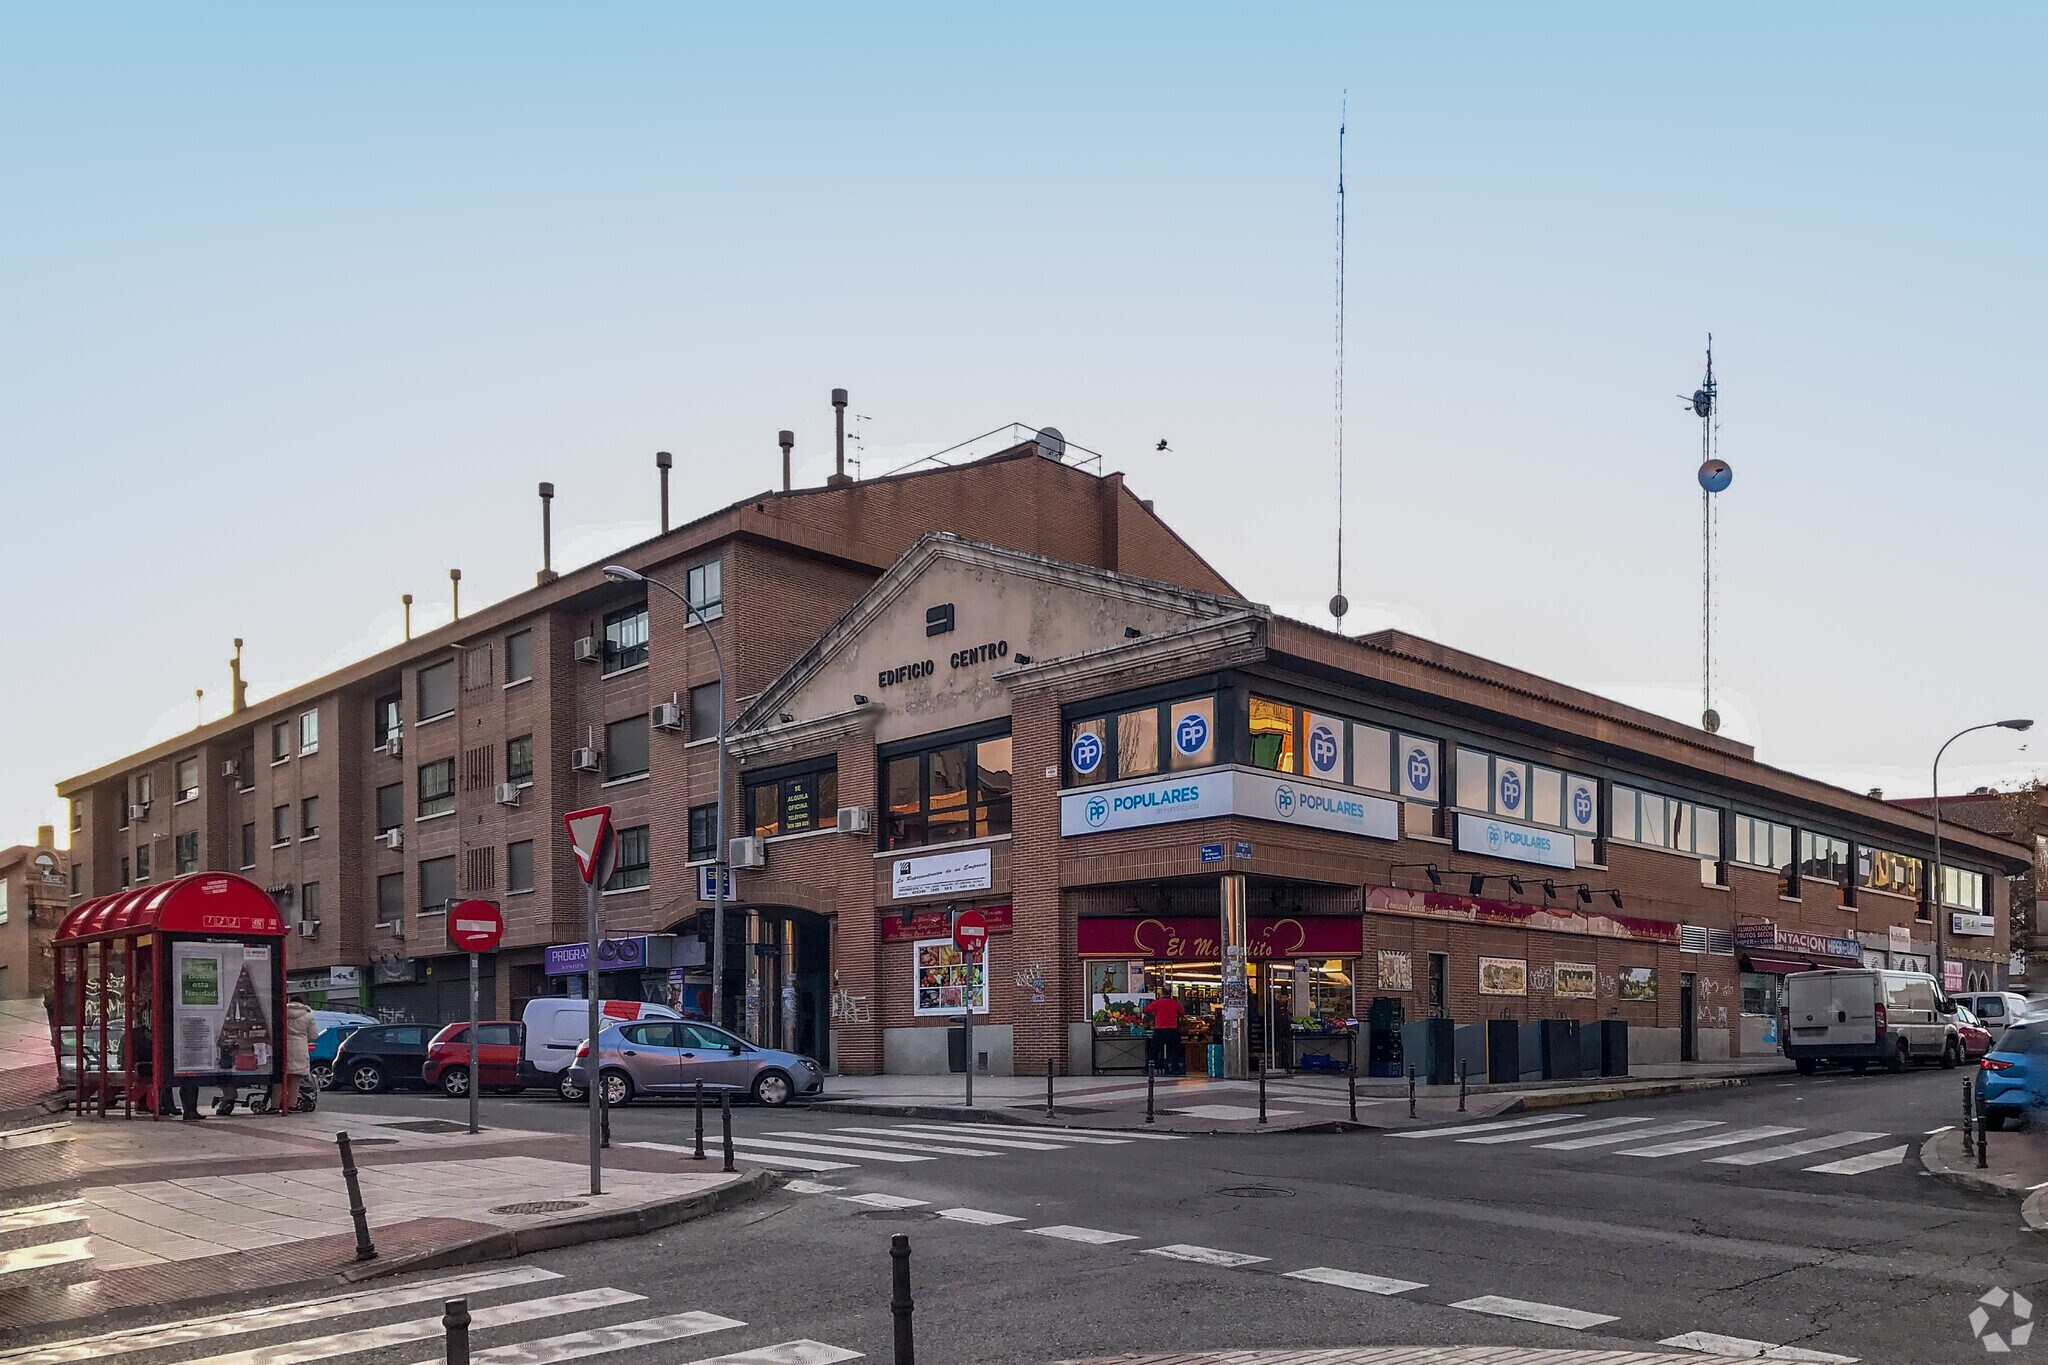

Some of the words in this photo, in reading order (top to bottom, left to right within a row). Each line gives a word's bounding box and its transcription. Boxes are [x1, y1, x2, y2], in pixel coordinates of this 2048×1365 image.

[878, 659, 935, 688] EDIFICIO
[950, 640, 1008, 669] CENTRO
[1182, 725, 1204, 747] PP
[1078, 745, 1097, 765] PP
[1314, 739, 1335, 764] PP
[1411, 760, 1429, 784] PP
[787, 793, 809, 802] ALQUILA
[1114, 786, 1199, 812] POPULARES
[1504, 782, 1519, 803] PP
[788, 802, 808, 811] OFICINA
[1300, 793, 1364, 818] POPULARES
[1576, 798, 1590, 818] PP
[1503, 830, 1551, 851] POPULARES
[1166, 937, 1186, 957] El
[1776, 932, 1826, 954] NTACION
